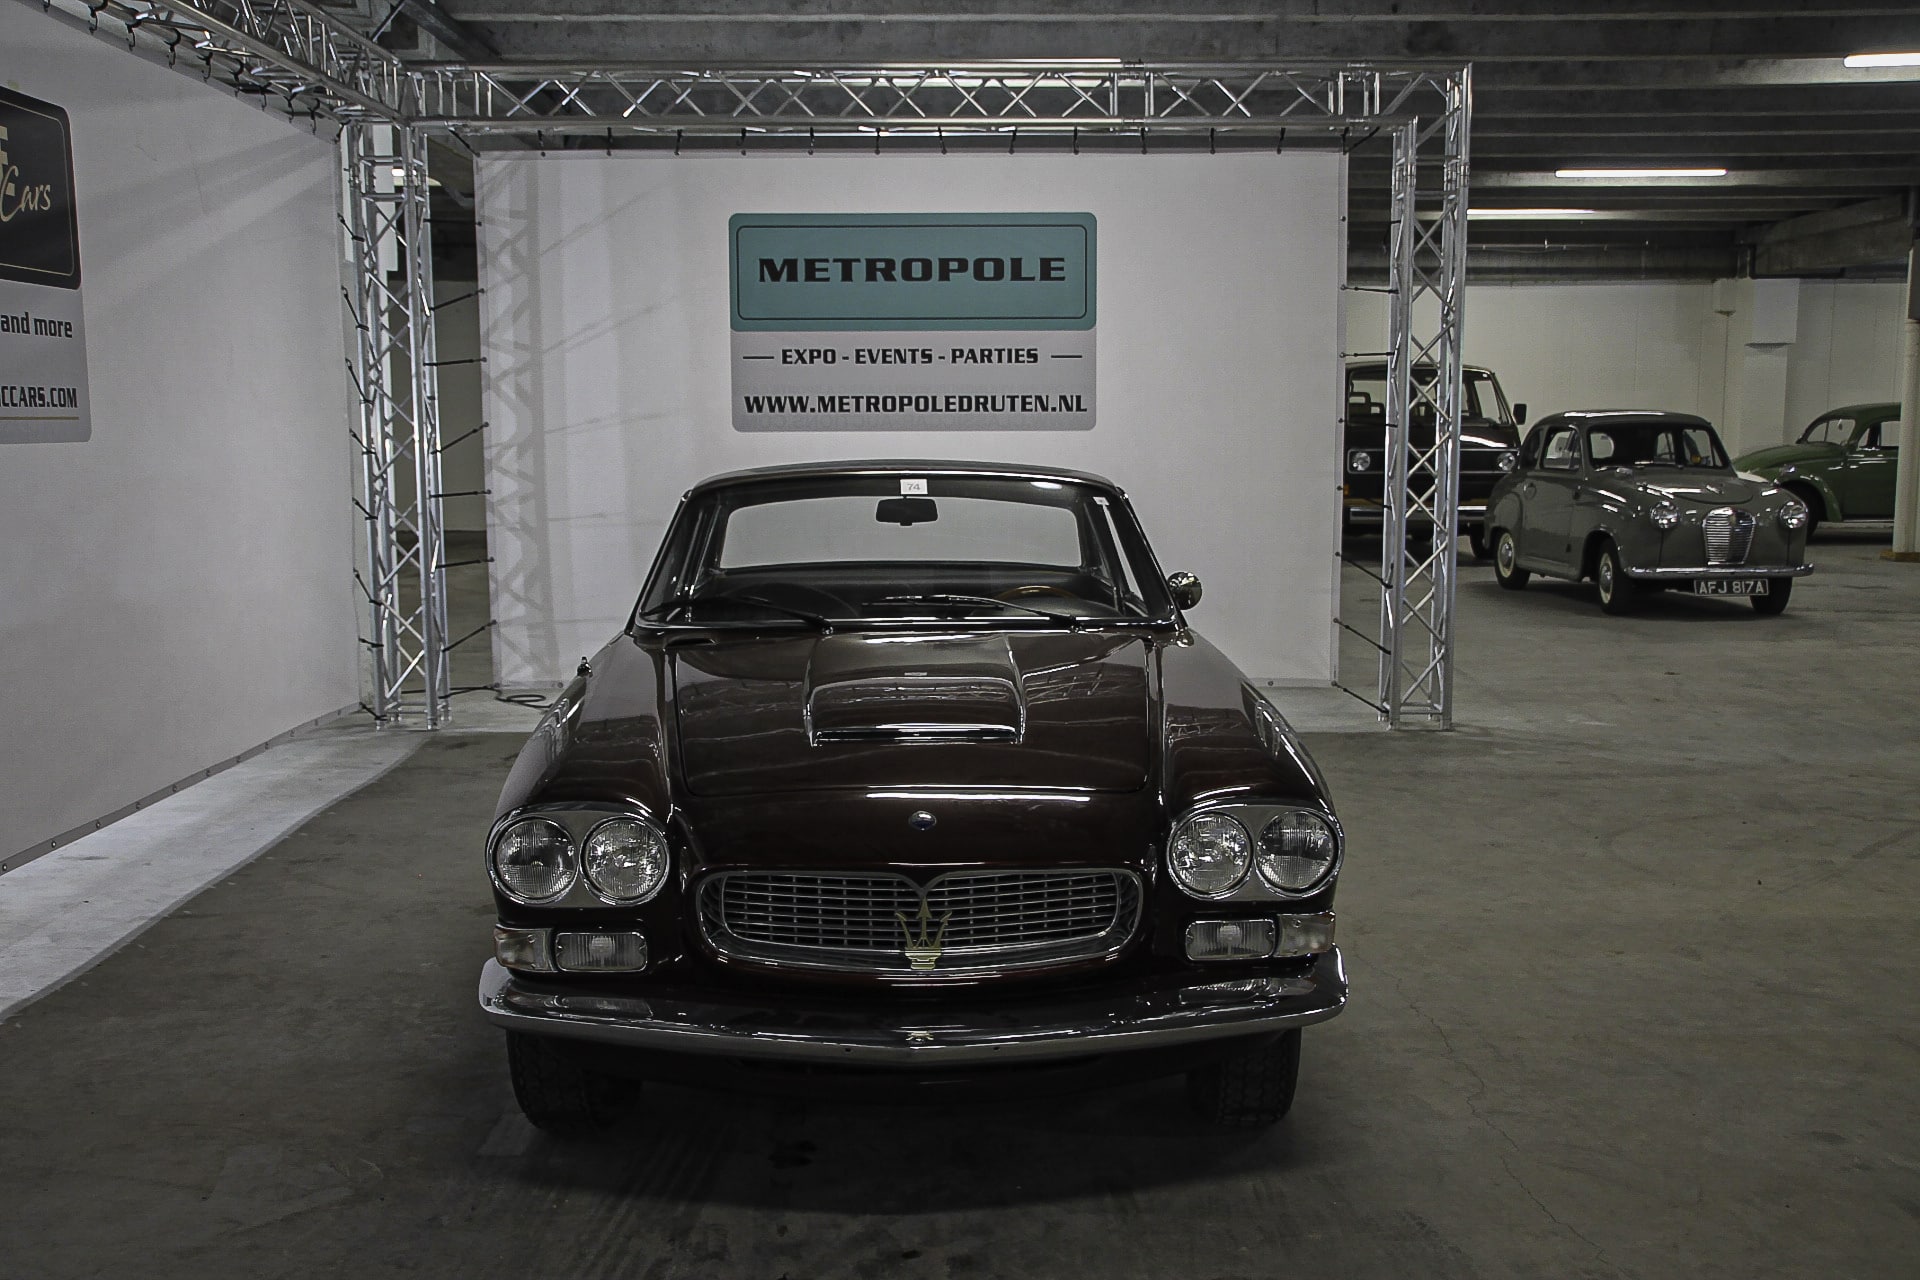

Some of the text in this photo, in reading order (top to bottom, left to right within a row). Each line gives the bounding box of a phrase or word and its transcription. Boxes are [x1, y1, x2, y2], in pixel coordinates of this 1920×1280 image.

[0, 165, 51, 222] Cars
[758, 257, 1066, 283] METROPOLE
[0, 311, 73, 339] and more
[781, 348, 837, 365] EXPO
[854, 348, 933, 365] EVENTS
[950, 347, 1039, 364] PARTIES
[0, 385, 78, 408] CCARS.COM
[744, 395, 1088, 414] WWW.METROPOLEDRUTEN.NL
[1699, 580, 1765, 594] AFJ 817A
